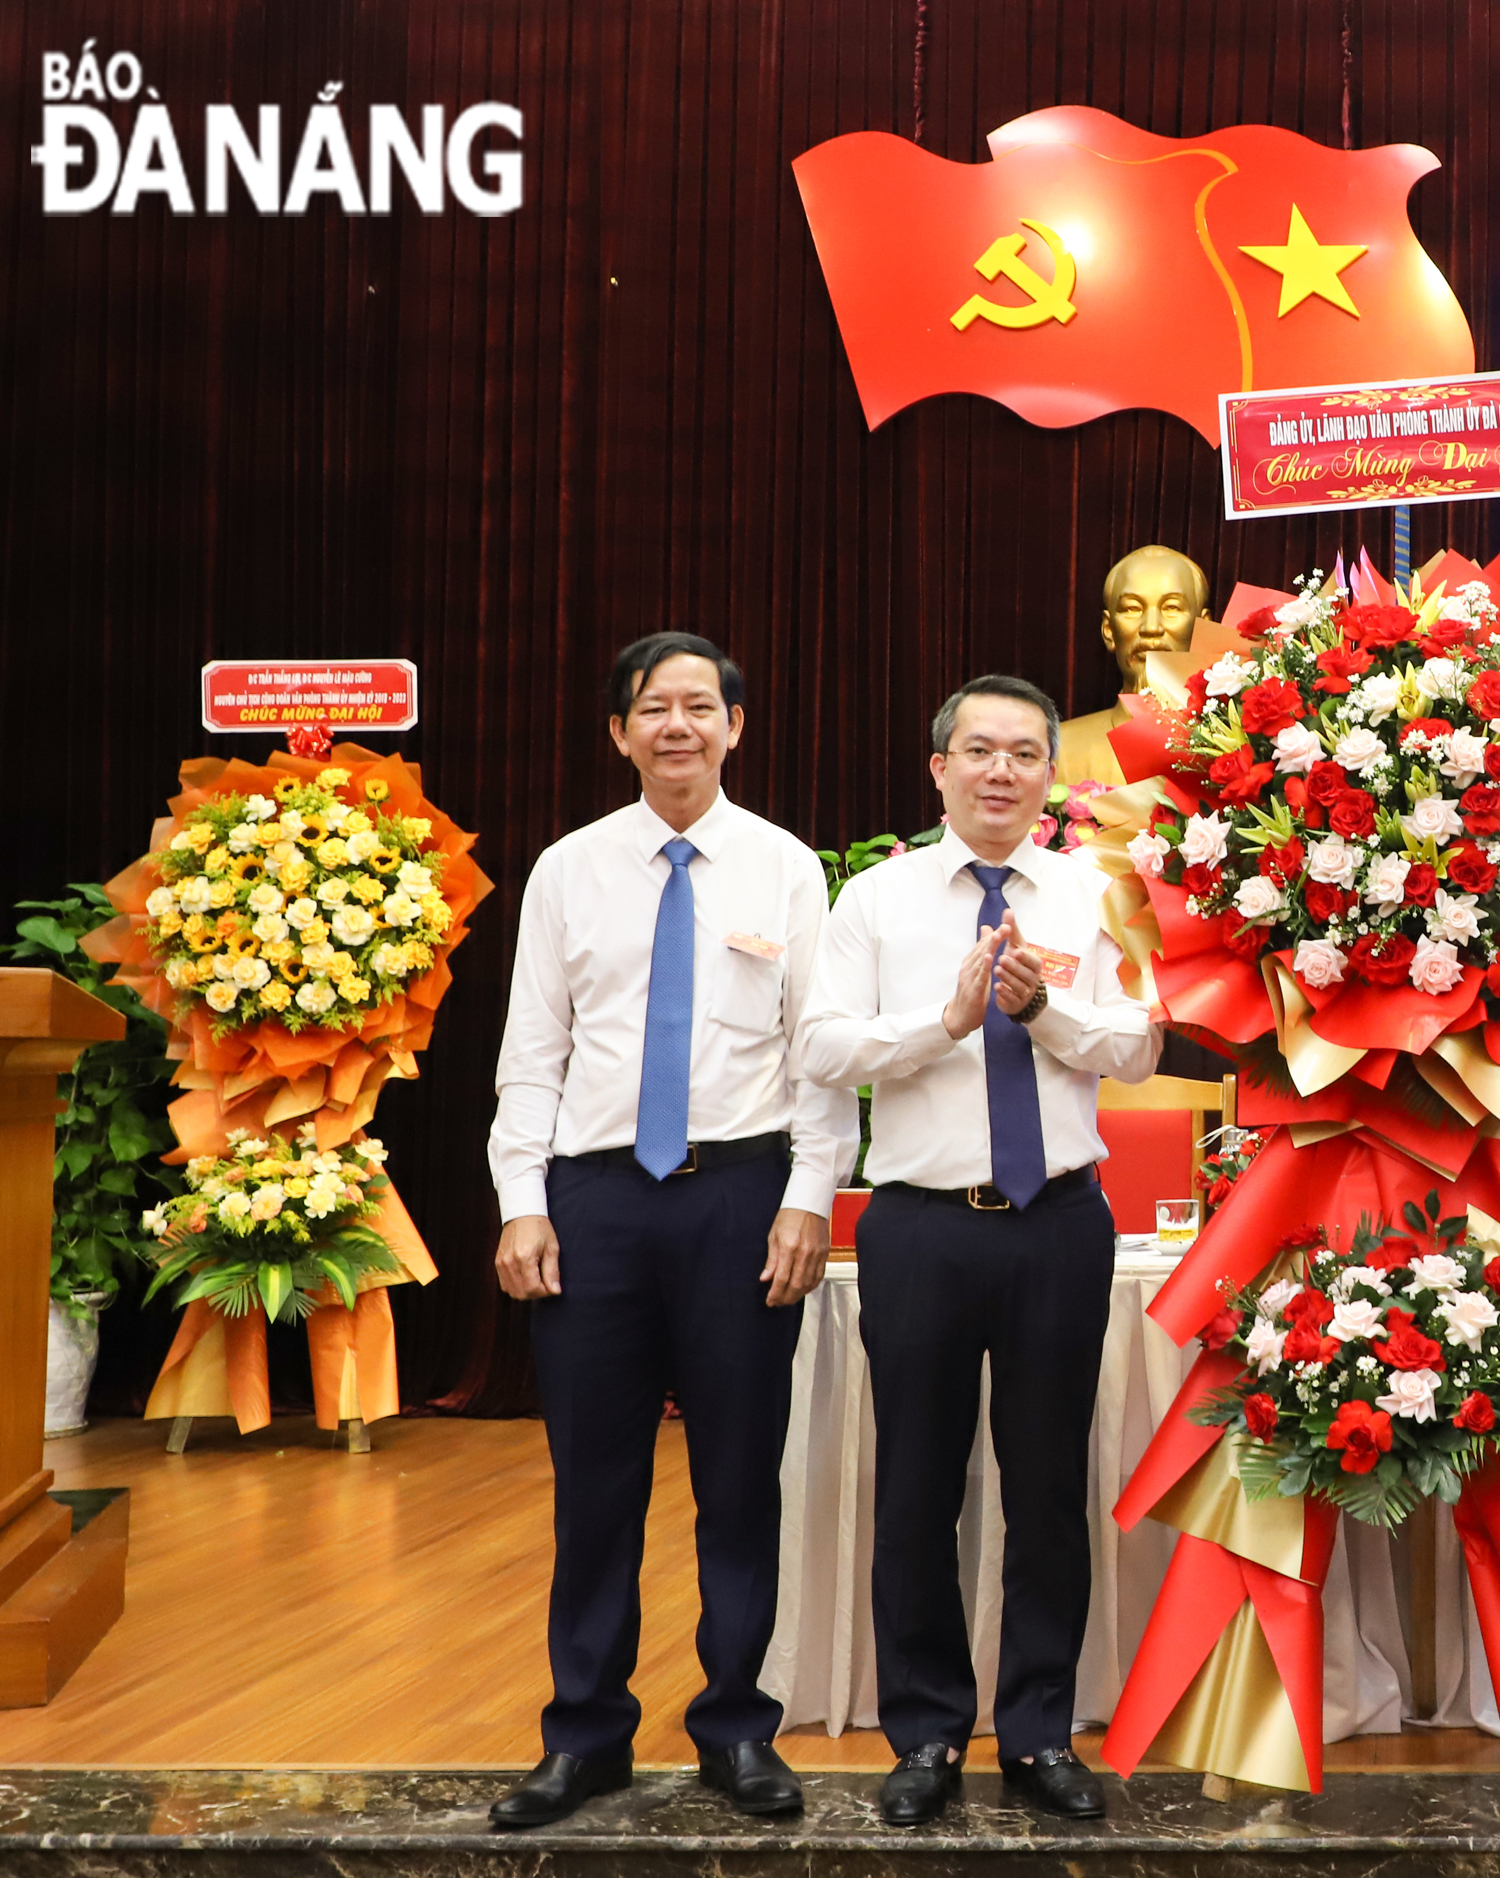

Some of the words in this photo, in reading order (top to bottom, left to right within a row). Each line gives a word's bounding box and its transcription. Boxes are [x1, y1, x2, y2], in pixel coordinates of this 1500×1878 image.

[1269, 413, 1299, 446] ĐẢNG
[1300, 411, 1316, 446] ỦY,
[1316, 413, 1345, 442] LÃNH
[1346, 415, 1368, 445] ĐẠO
[1368, 409, 1392, 438] VĂN
[1393, 405, 1428, 436] PHÒNG
[1429, 404, 1465, 433] THÀNH
[1466, 399, 1480, 431] ỦY
[1481, 400, 1498, 429] ĐÀ
[1253, 451, 1328, 495] Chúc
[1331, 444, 1415, 487] Mừng
[239, 705, 278, 721] CHÚC
[281, 704, 326, 721] MỪNG
[329, 706, 354, 722] ĐẠI
[357, 704, 383, 722] HỘI
